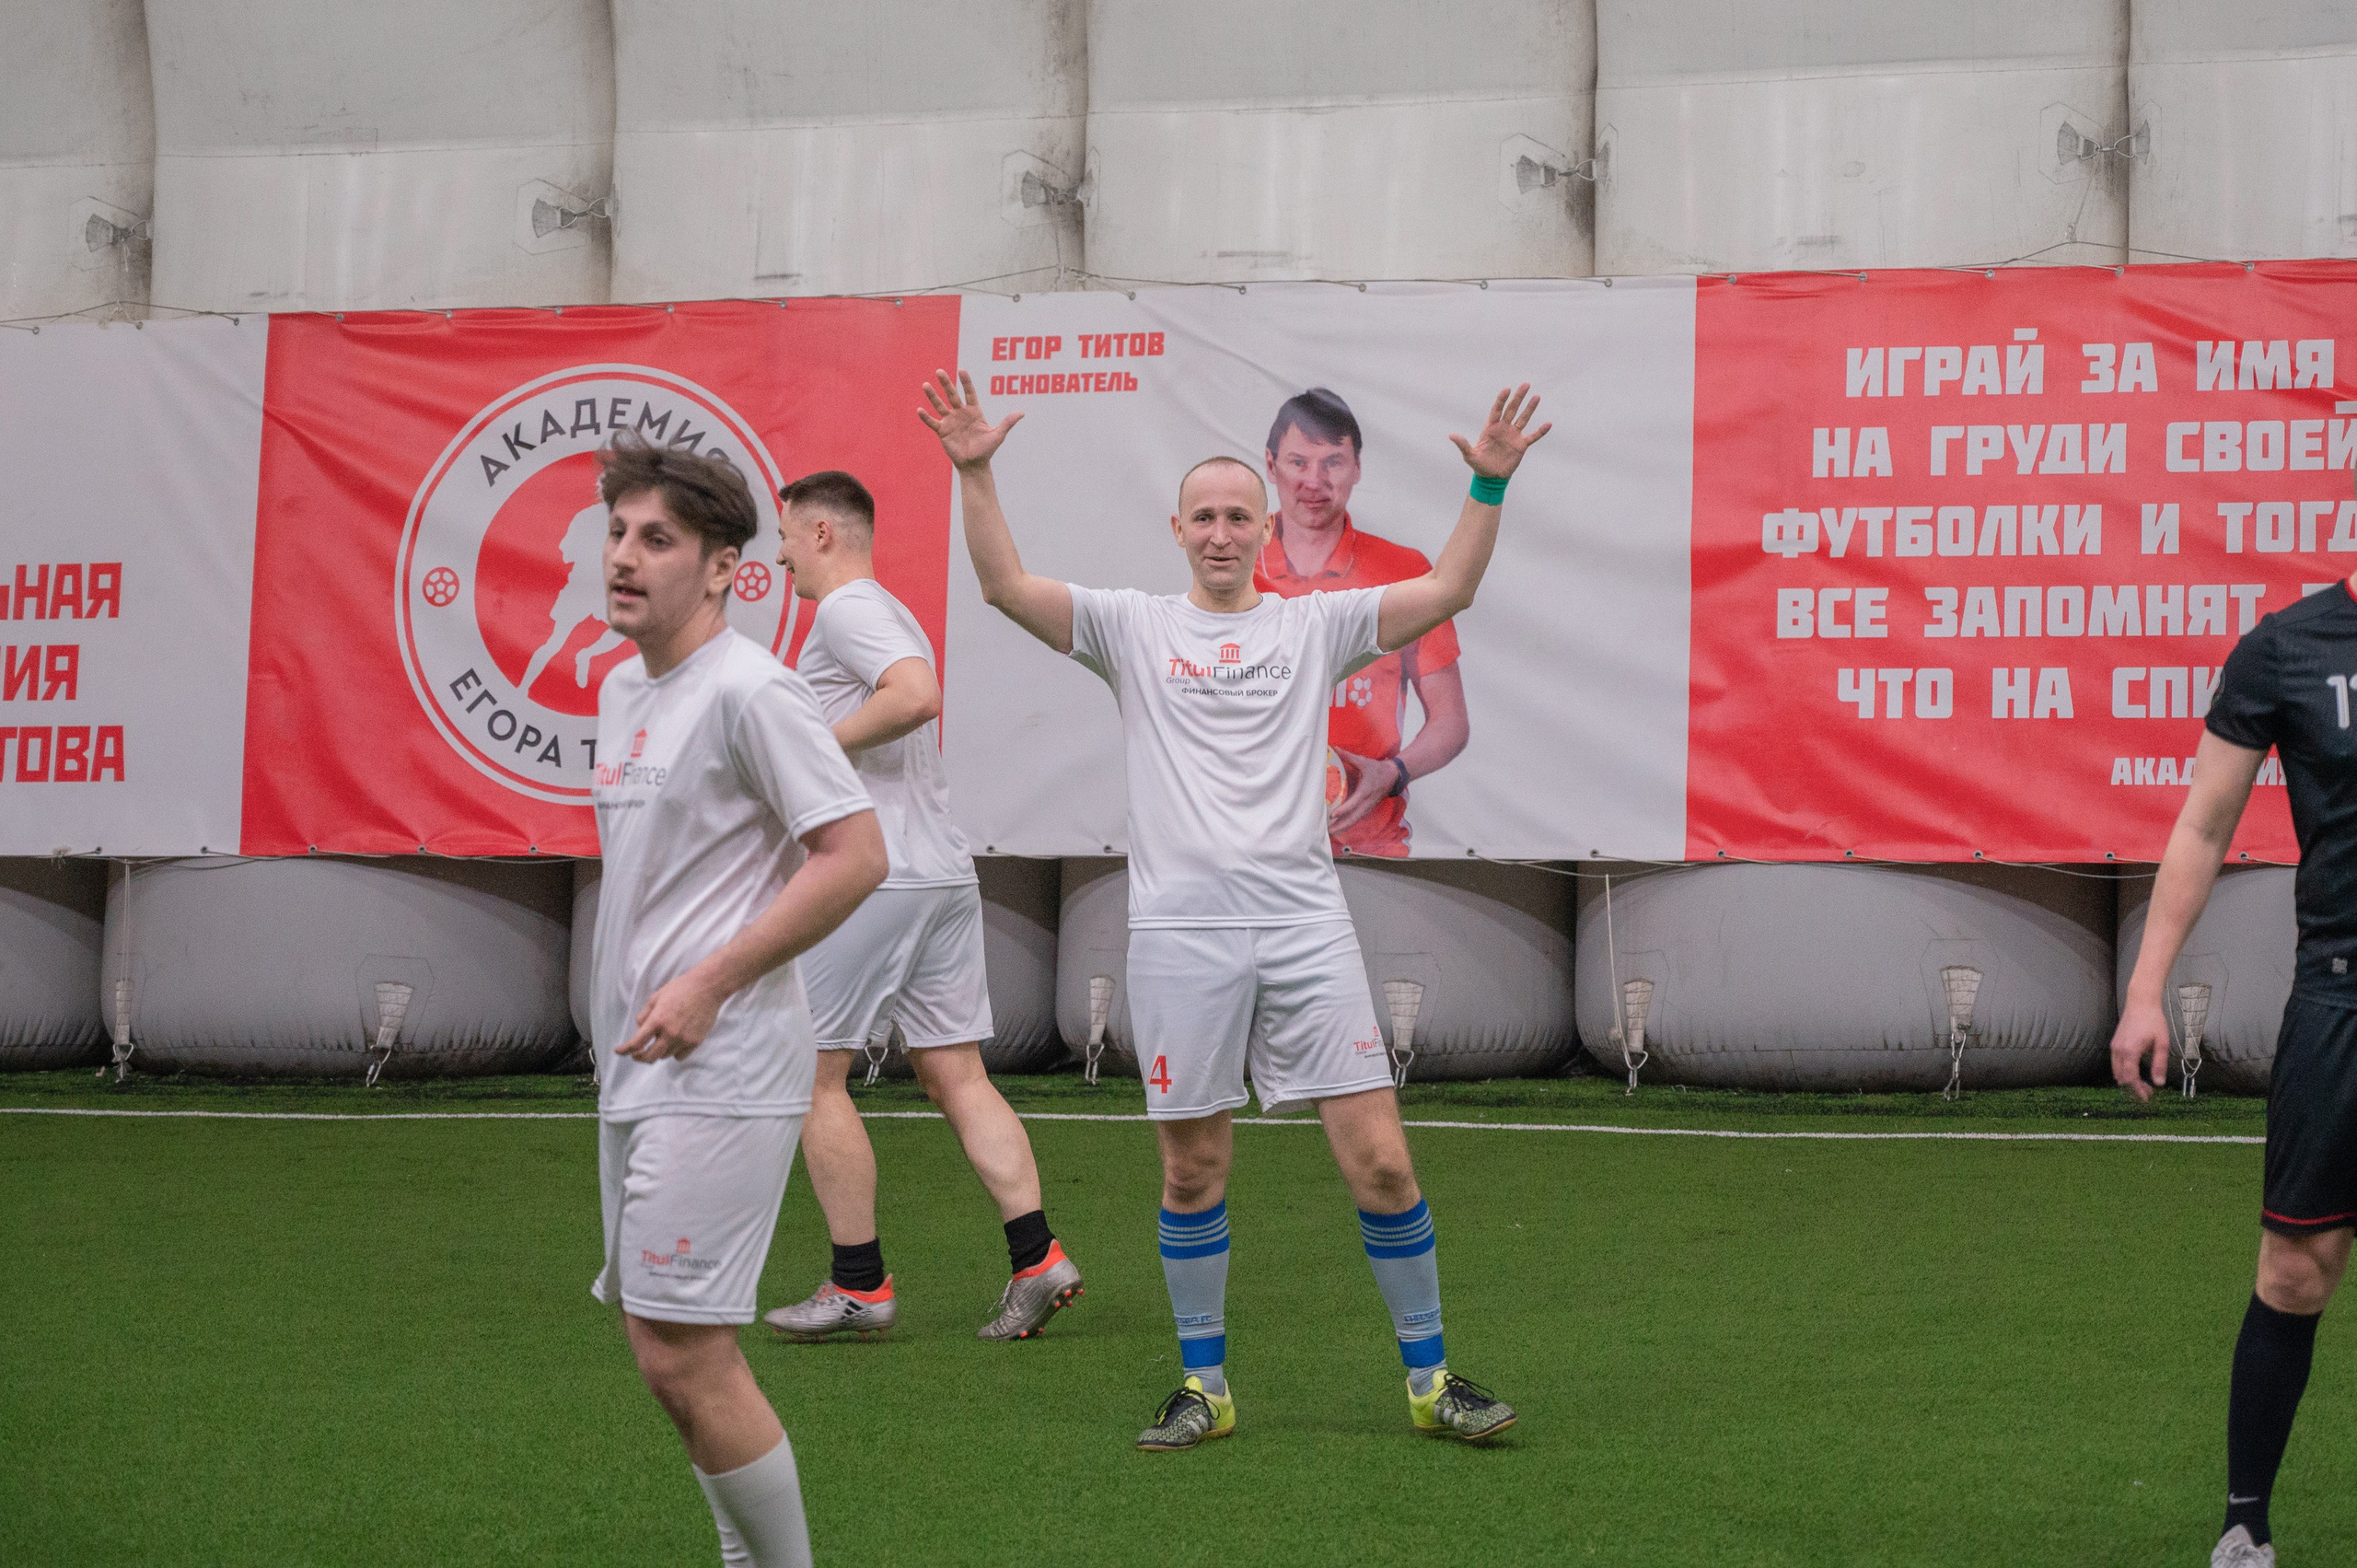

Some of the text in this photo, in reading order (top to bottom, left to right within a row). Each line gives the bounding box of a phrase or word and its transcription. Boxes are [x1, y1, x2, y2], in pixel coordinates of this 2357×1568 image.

[992, 331, 1166, 362] ЕГОР ТИТОВ
[1846, 328, 2335, 398] ИГРАЙ ЗА ИМЯ
[990, 371, 1139, 396] ОСНОВАТЕЛЬ
[1812, 401, 2357, 479] НА ГРУДИ СВОЕЙ
[1762, 504, 2103, 559] ФУТБОЛКИ
[2141, 503, 2180, 555] И
[1776, 584, 2267, 639] ВСЕ ЗАПОМНЯТ
[0, 644, 80, 702] ИЯ
[1166, 676, 1190, 685] Group
[1181, 687, 1244, 697] ФИНАНСОВЫЙ
[1837, 668, 1954, 719] ЧТО
[1991, 667, 2074, 719] НА
[448, 668, 563, 769] ЕГОРА
[1149, 1055, 1172, 1094] 4
